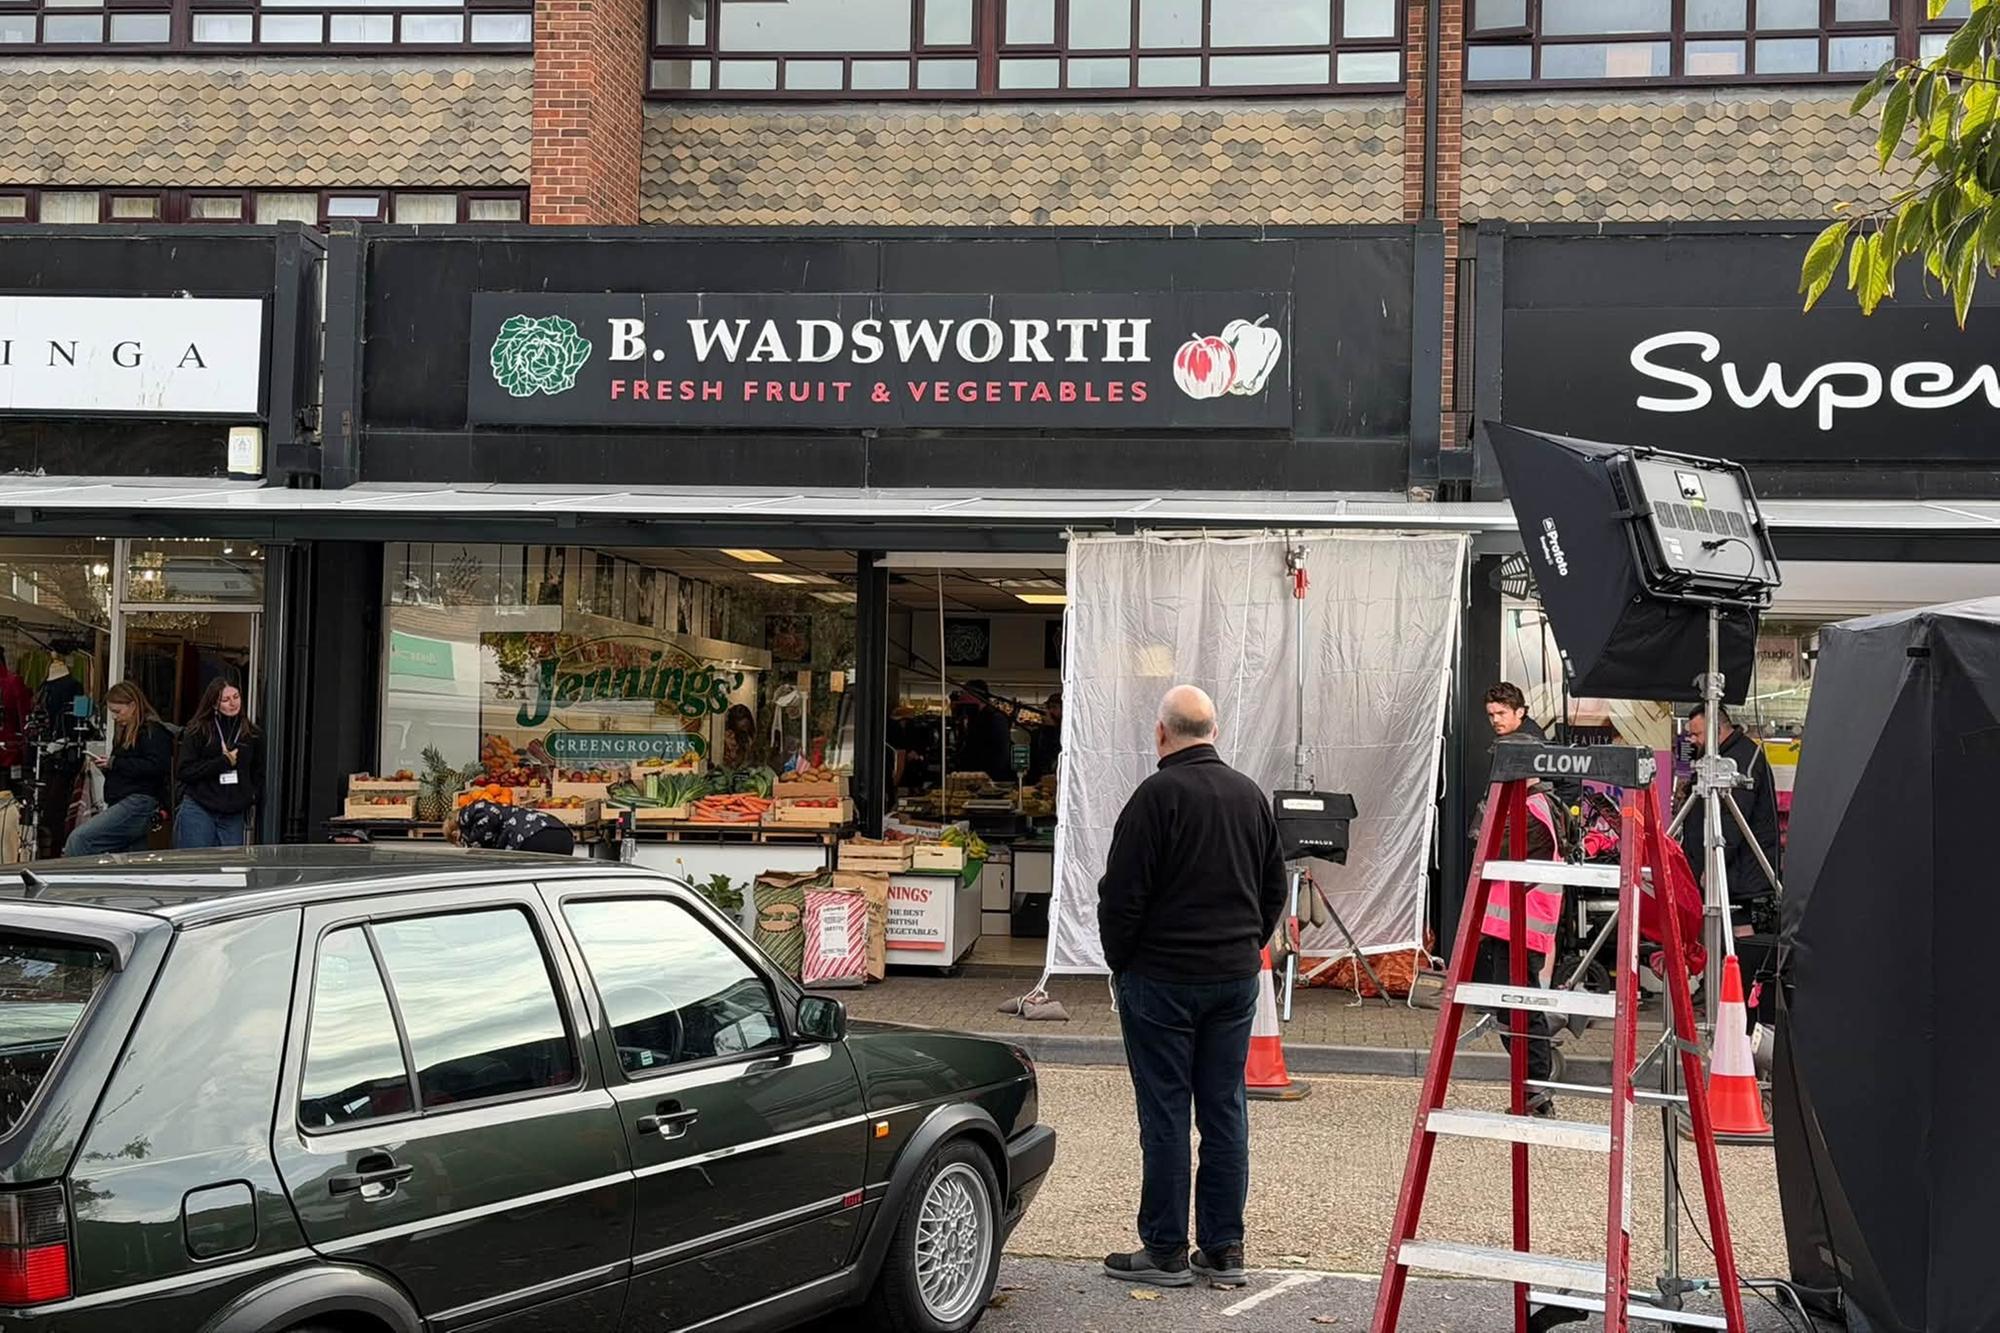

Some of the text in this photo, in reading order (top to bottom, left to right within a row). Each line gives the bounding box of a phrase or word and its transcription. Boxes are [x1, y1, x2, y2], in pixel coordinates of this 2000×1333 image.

[607, 317, 1153, 364] B. WADSWORTH
[610, 379, 1149, 403] FRESH FRUIT & VEGETABLES
[1546, 530, 1568, 577] Profoto
[553, 737, 697, 754] GREENGROCERS
[1533, 753, 1592, 773] CLOW
[903, 908, 926, 917] BEST
[884, 927, 939, 936] VEGETABLES
